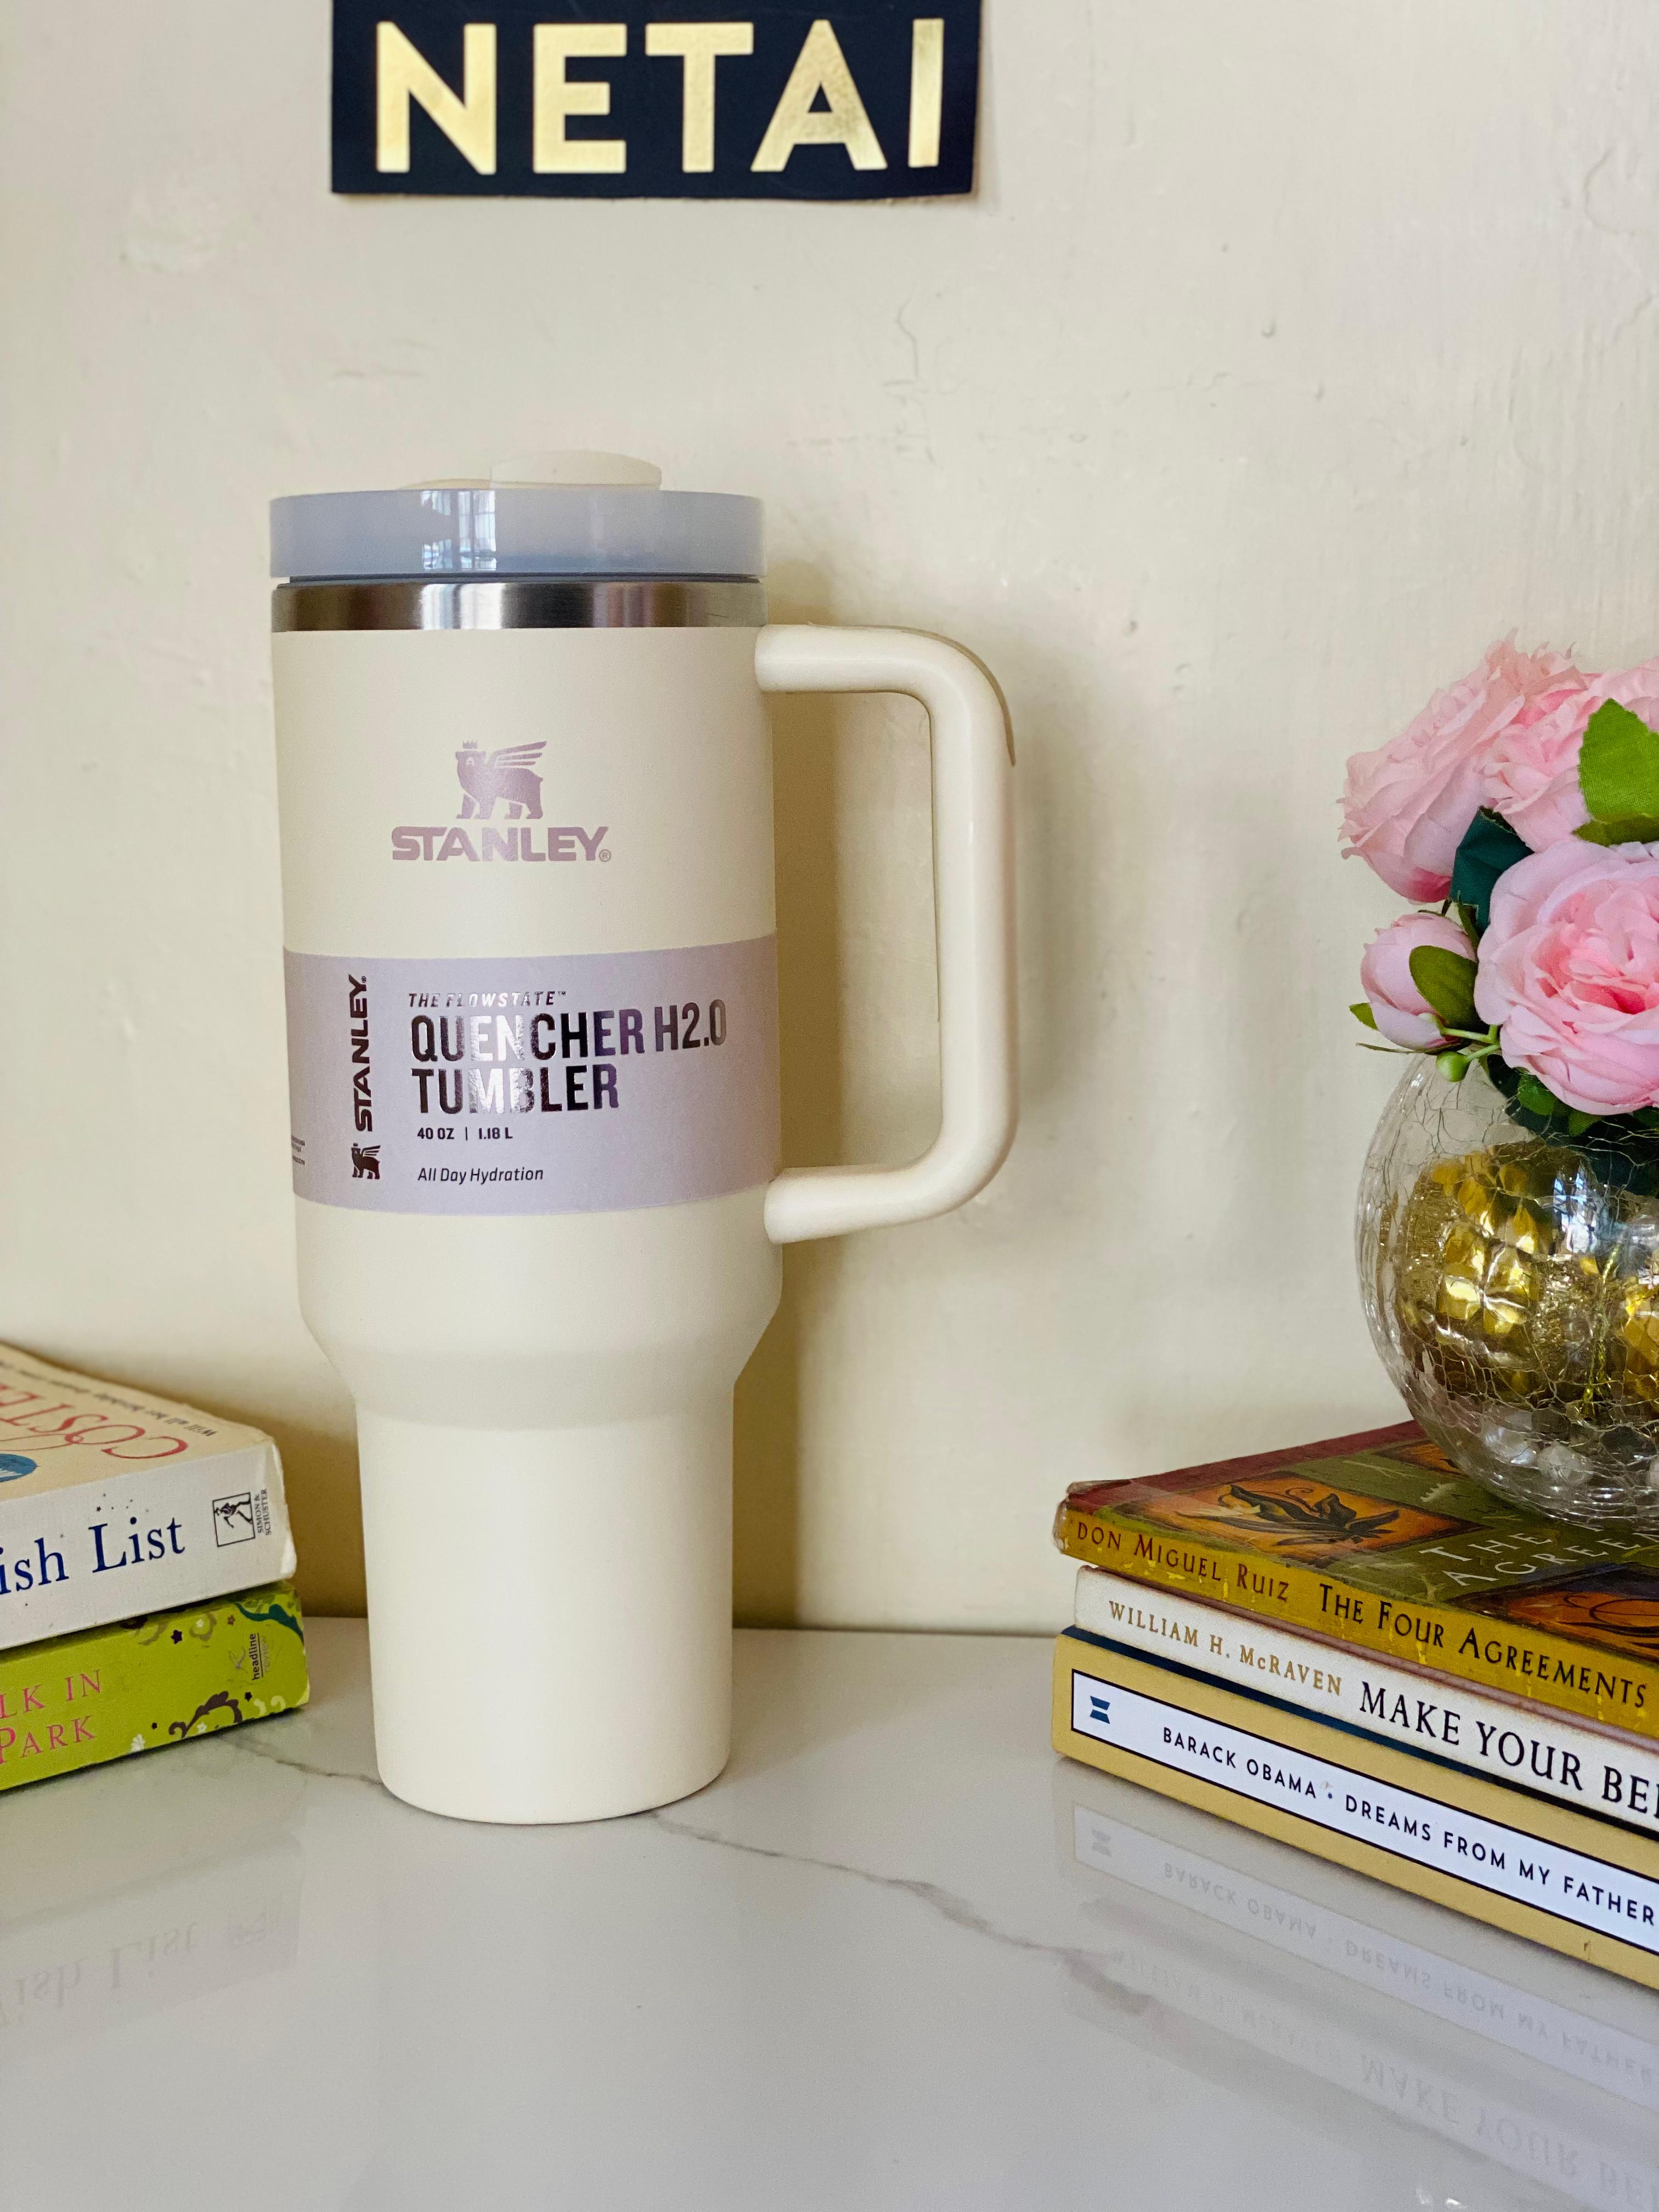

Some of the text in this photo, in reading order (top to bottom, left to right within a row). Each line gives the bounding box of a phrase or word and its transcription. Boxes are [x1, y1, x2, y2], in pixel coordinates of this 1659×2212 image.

[375, 19, 944, 176] NETAI
[409, 992, 439, 1008] THE
[410, 998, 727, 1063] QUENCHER H2.0
[410, 1063, 620, 1115] TUMBLER
[417, 1127, 514, 1141] 40 OZ 1.18 L
[417, 1166, 544, 1186] All Day Hydration
[253, 1493, 264, 1534] SIMON &
[260, 1488, 272, 1536] SCHUSTER
[88, 1516, 185, 1573] List
[1419, 1533, 1553, 1561] THE
[1077, 1522, 1646, 1708] DON MIGUEL RUIZ THE FOUR AGREEMENTS
[249, 1633, 261, 1680] headline
[64, 1669, 101, 1702] IN
[1108, 1600, 1659, 1819] WILLIAM H. McRAVEN MAKE YOUR BE
[0, 1715, 96, 1764] PARK
[1163, 1726, 1655, 1926] BARACK OBAMA DREAMS FROM MY FATHER
